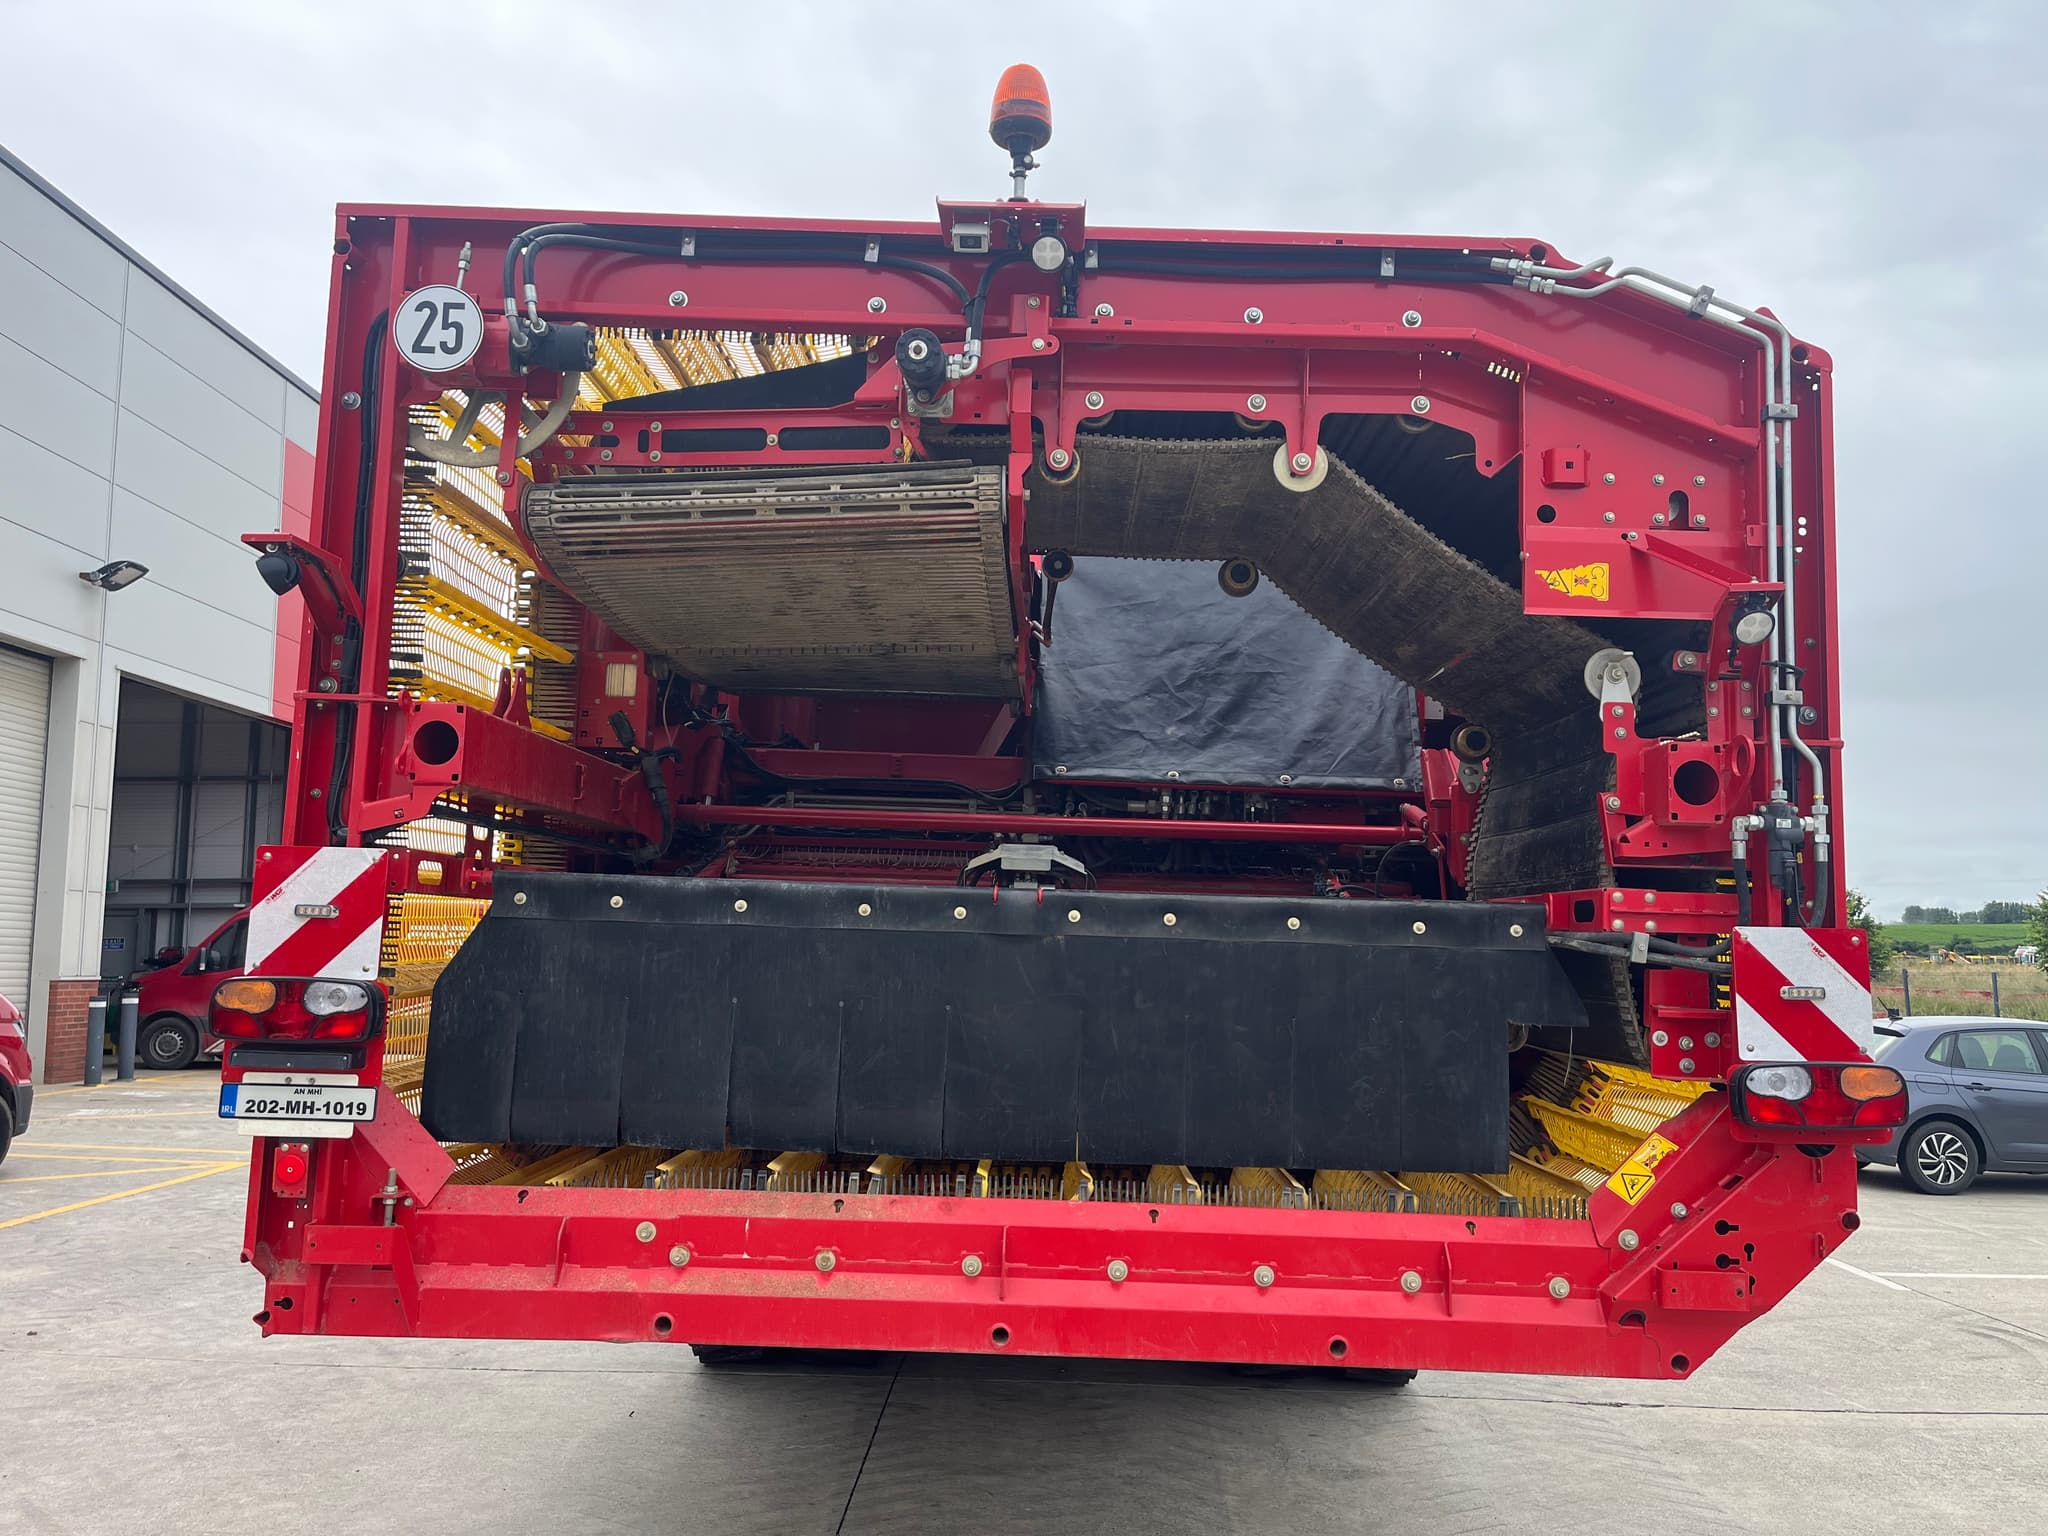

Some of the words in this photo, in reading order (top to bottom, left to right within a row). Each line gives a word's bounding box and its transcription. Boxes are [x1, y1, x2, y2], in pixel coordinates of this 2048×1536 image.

[411, 300, 466, 356] 25
[221, 1104, 235, 1114] IRL
[244, 1099, 368, 1116] 202-MH-1019
